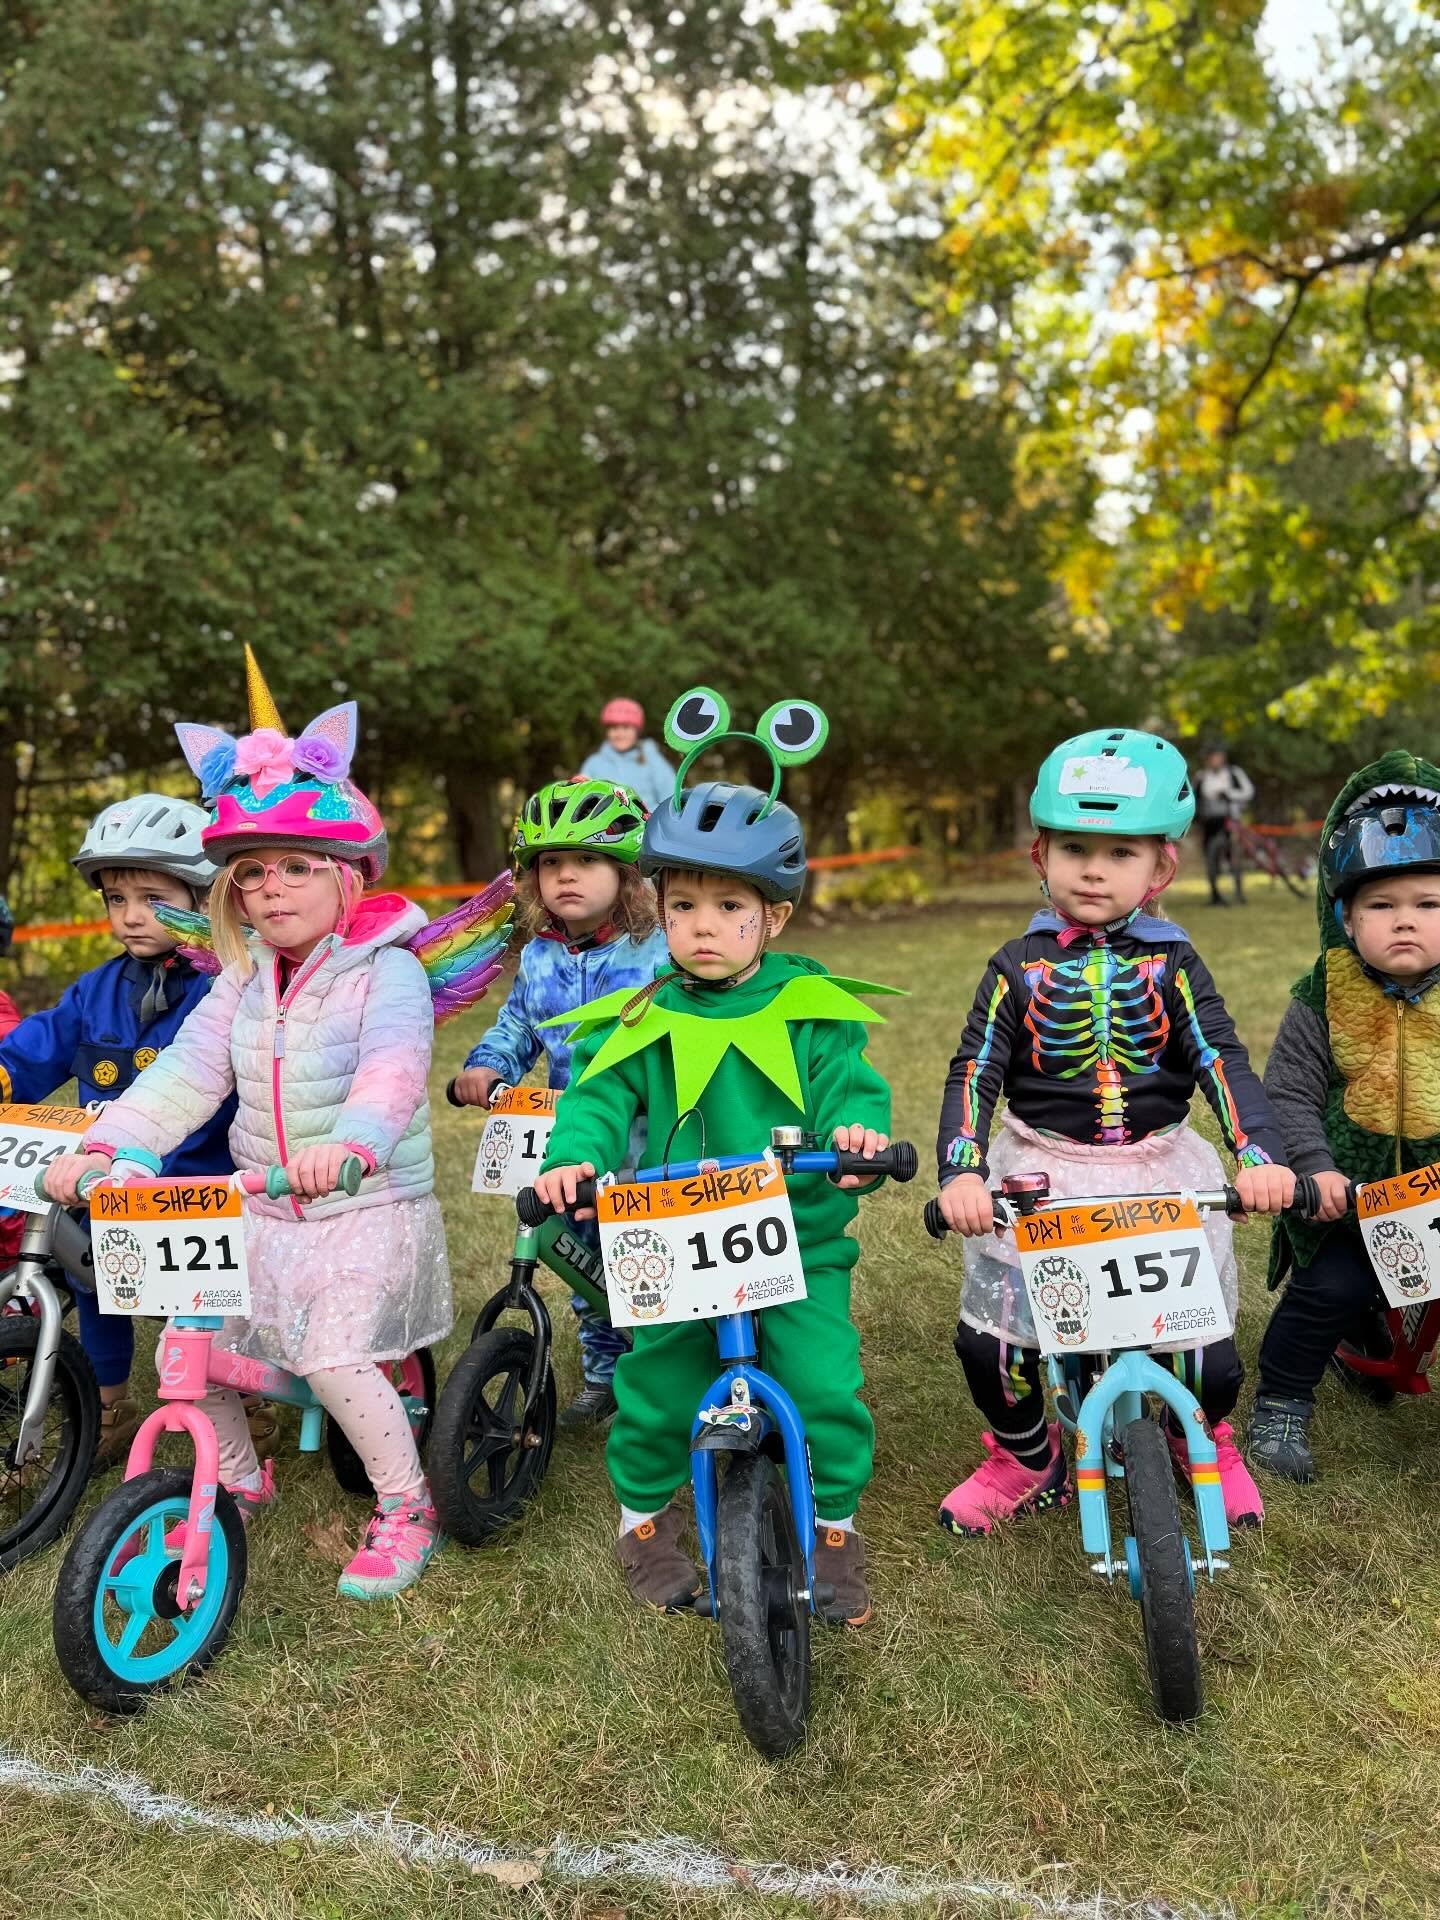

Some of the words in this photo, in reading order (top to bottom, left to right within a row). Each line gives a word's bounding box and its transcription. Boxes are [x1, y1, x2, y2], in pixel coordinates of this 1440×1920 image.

[24, 1106, 86, 1126] SHRED
[136, 1193, 144, 1201] OF
[152, 1186, 228, 1213] SHRED
[661, 1188, 670, 1196] OF
[681, 1167, 770, 1206] SHRED
[1363, 1184, 1389, 1211] DAY
[99, 1190, 129, 1216] DAY
[136, 1203, 147, 1211] THE
[610, 1187, 650, 1216] DAY
[660, 1198, 676, 1208] THE
[1025, 1215, 1062, 1244] DAY
[1070, 1215, 1080, 1223] OF
[1070, 1224, 1086, 1234] THE
[1091, 1200, 1181, 1232] SHRED
[157, 1235, 239, 1272] 121
[688, 1217, 788, 1270] 160
[1101, 1247, 1200, 1298] 157
